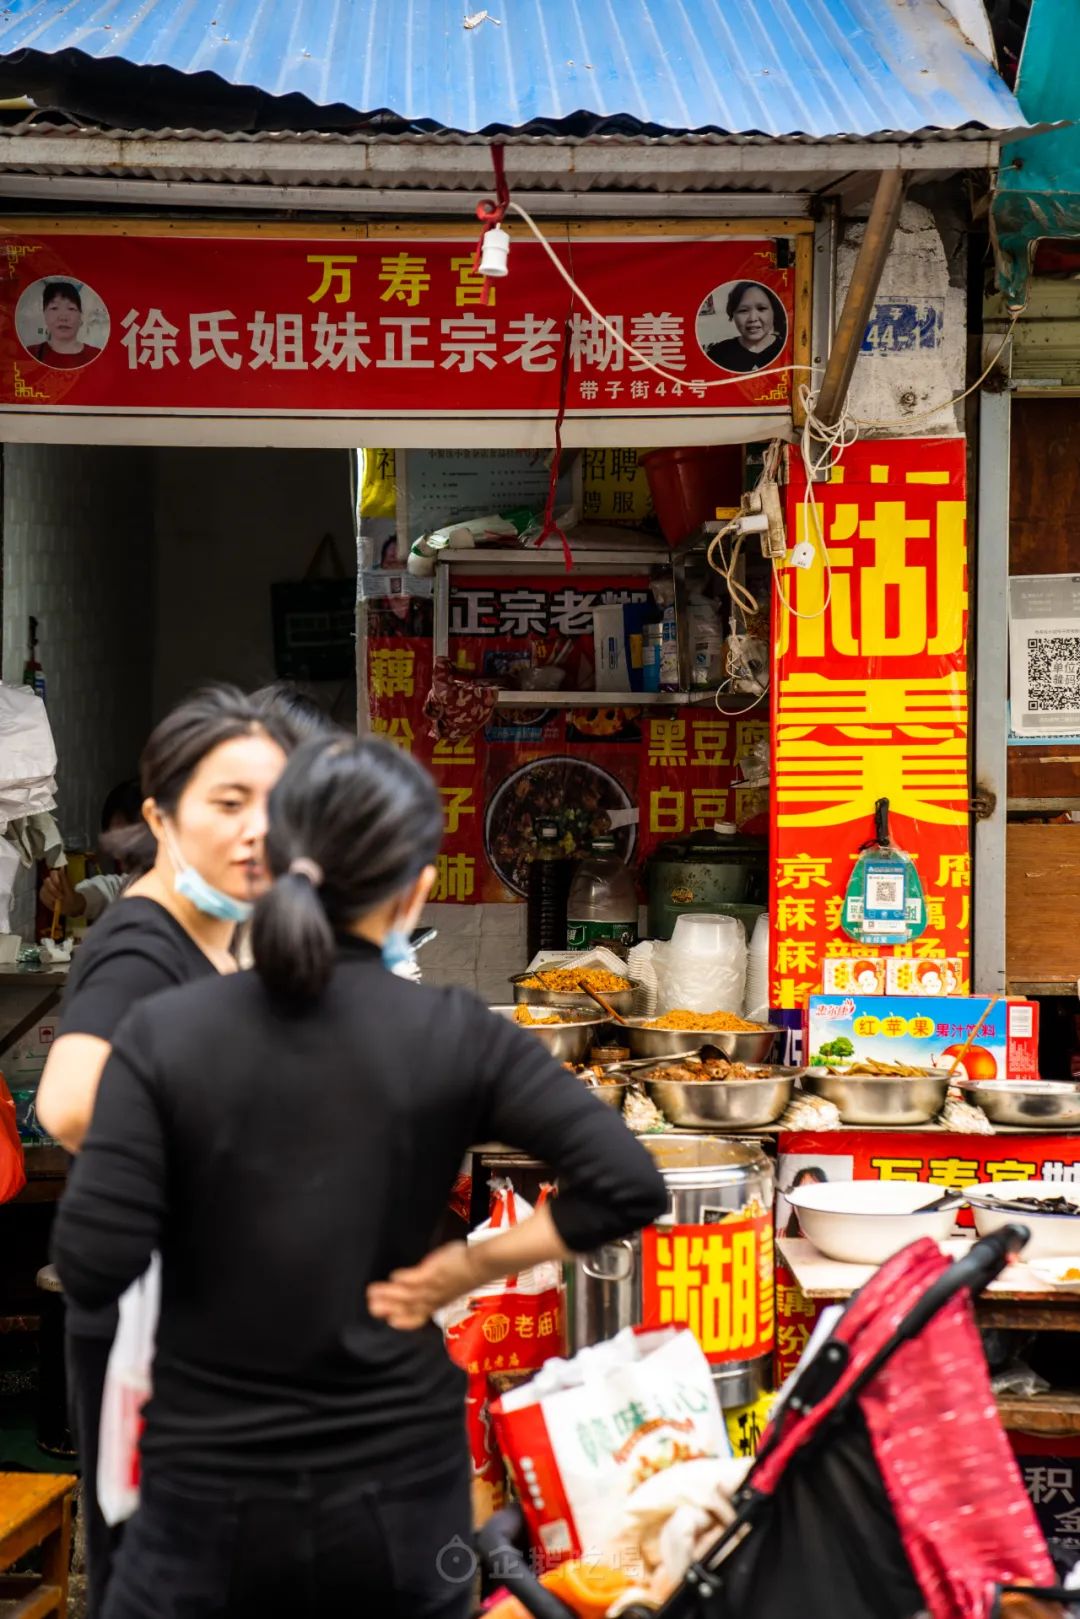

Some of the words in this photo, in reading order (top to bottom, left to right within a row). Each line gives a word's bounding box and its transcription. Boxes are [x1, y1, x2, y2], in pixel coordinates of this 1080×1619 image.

[307, 252, 497, 307] 万寿宫
[120, 308, 687, 373] 徐氏姐妹正宗老糊羹
[579, 379, 708, 400] 带子街44号
[582, 448, 639, 482] 招聘
[449, 590, 648, 636] 正宗老
[859, 1019, 929, 1037] 红苹果
[936, 1023, 996, 1038] 果汁饮料
